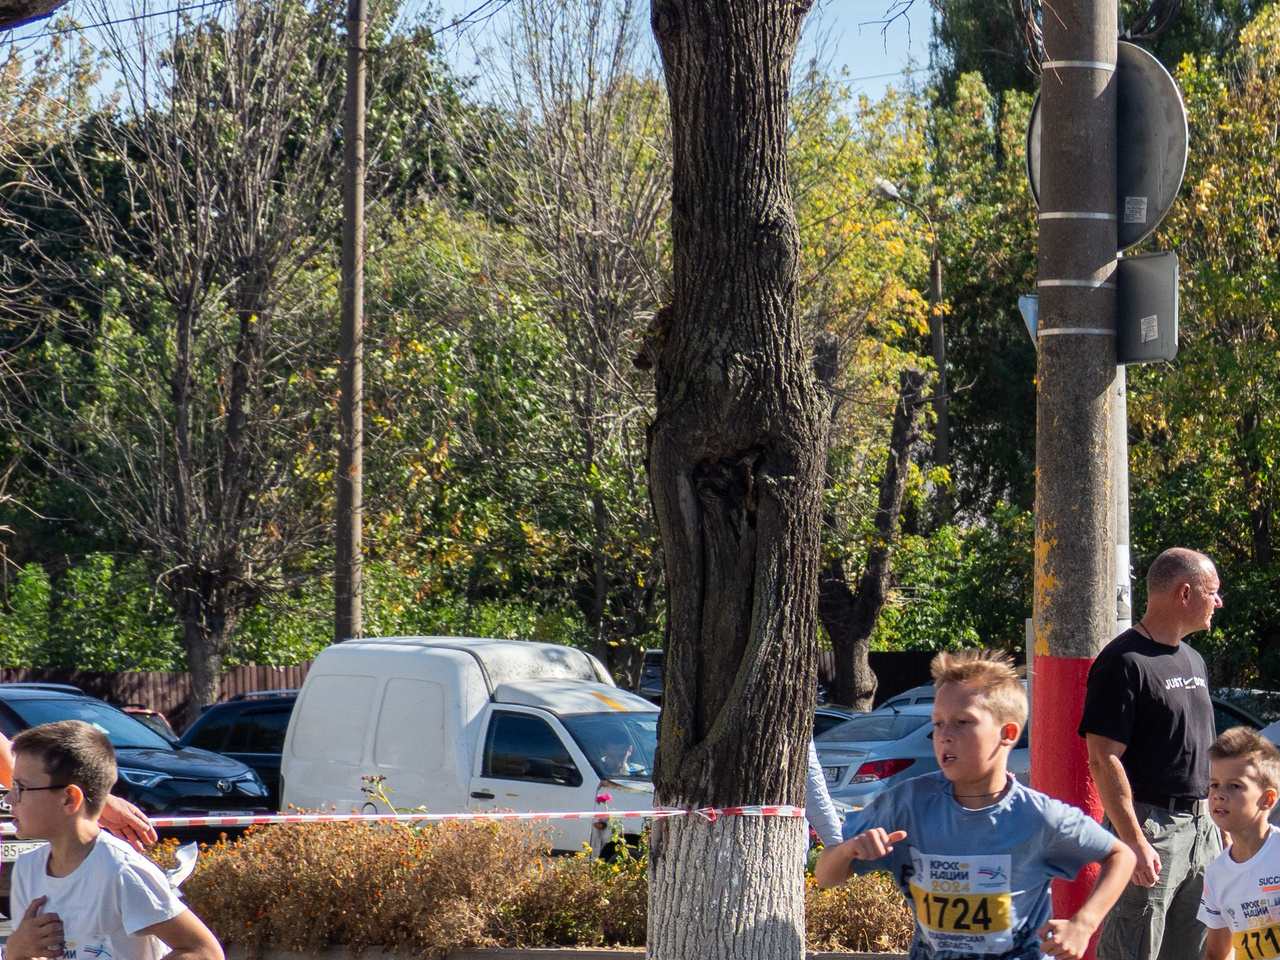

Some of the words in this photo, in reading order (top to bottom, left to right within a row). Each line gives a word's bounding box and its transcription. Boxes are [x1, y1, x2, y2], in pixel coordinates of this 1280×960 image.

[930, 861, 960, 870] КРОСС
[930, 870, 969, 880] НАЦИИ
[931, 880, 970, 892] 2024
[923, 893, 992, 931] 1724
